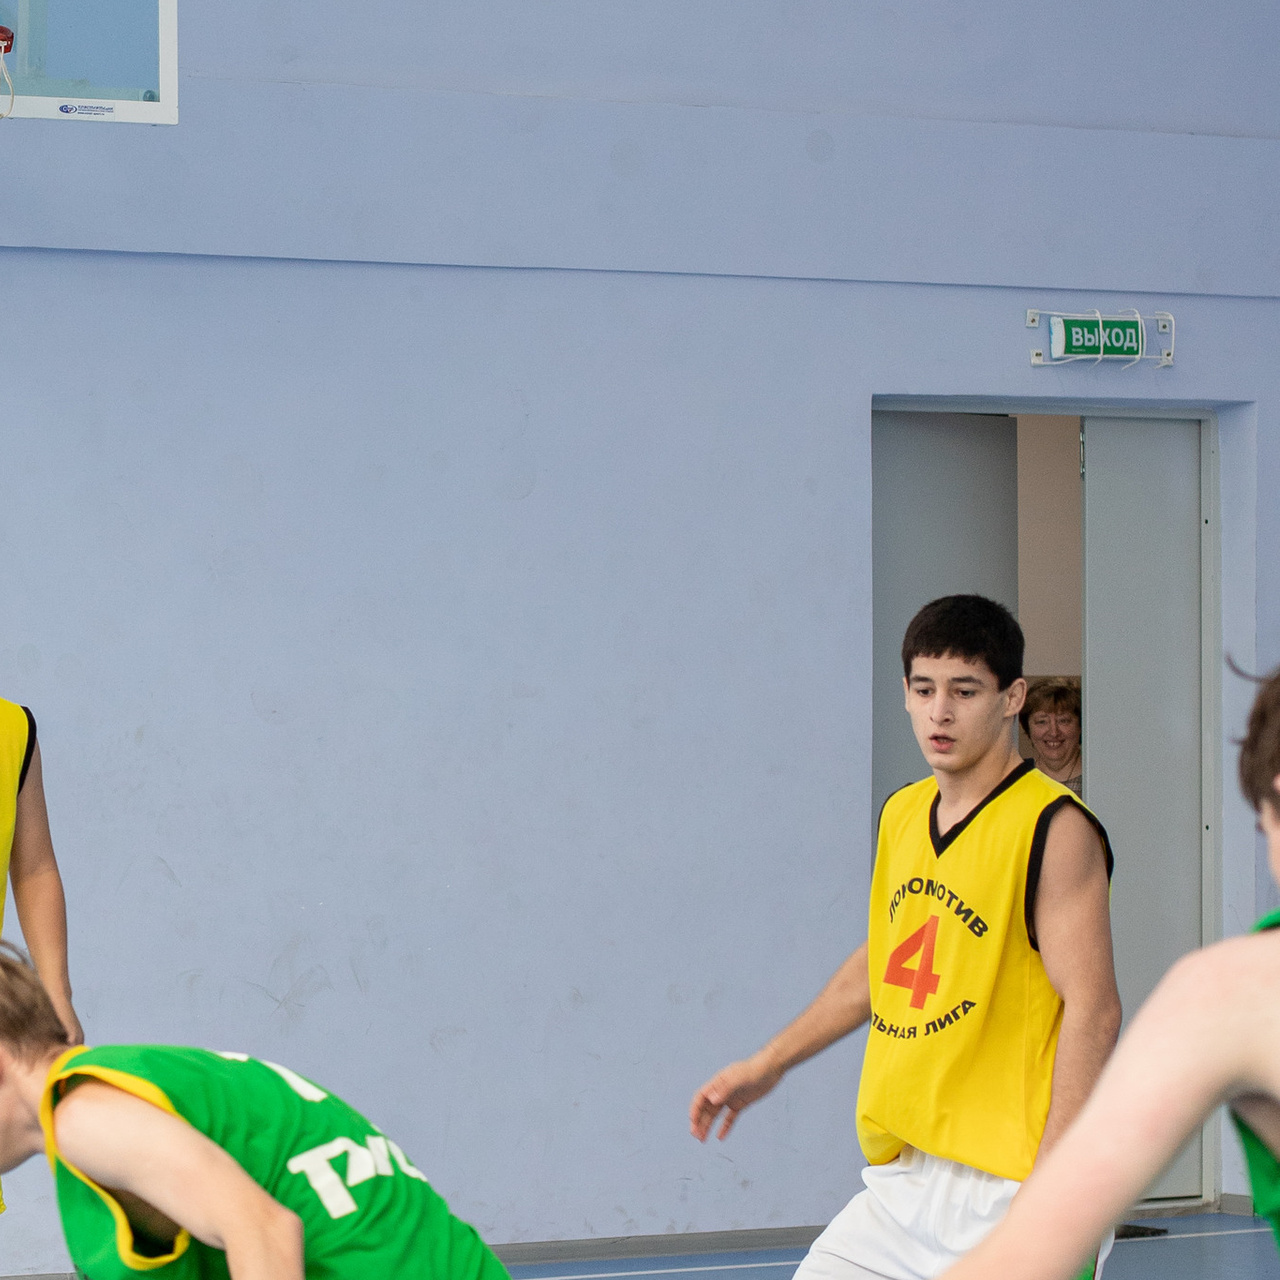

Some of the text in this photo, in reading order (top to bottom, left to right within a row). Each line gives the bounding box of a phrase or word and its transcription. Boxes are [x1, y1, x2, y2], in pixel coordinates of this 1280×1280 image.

[1072, 327, 1138, 351] ВЫХОД
[883, 915, 941, 1010] 4
[872, 999, 977, 1039] ЛЬНАЯ ЛИГА
